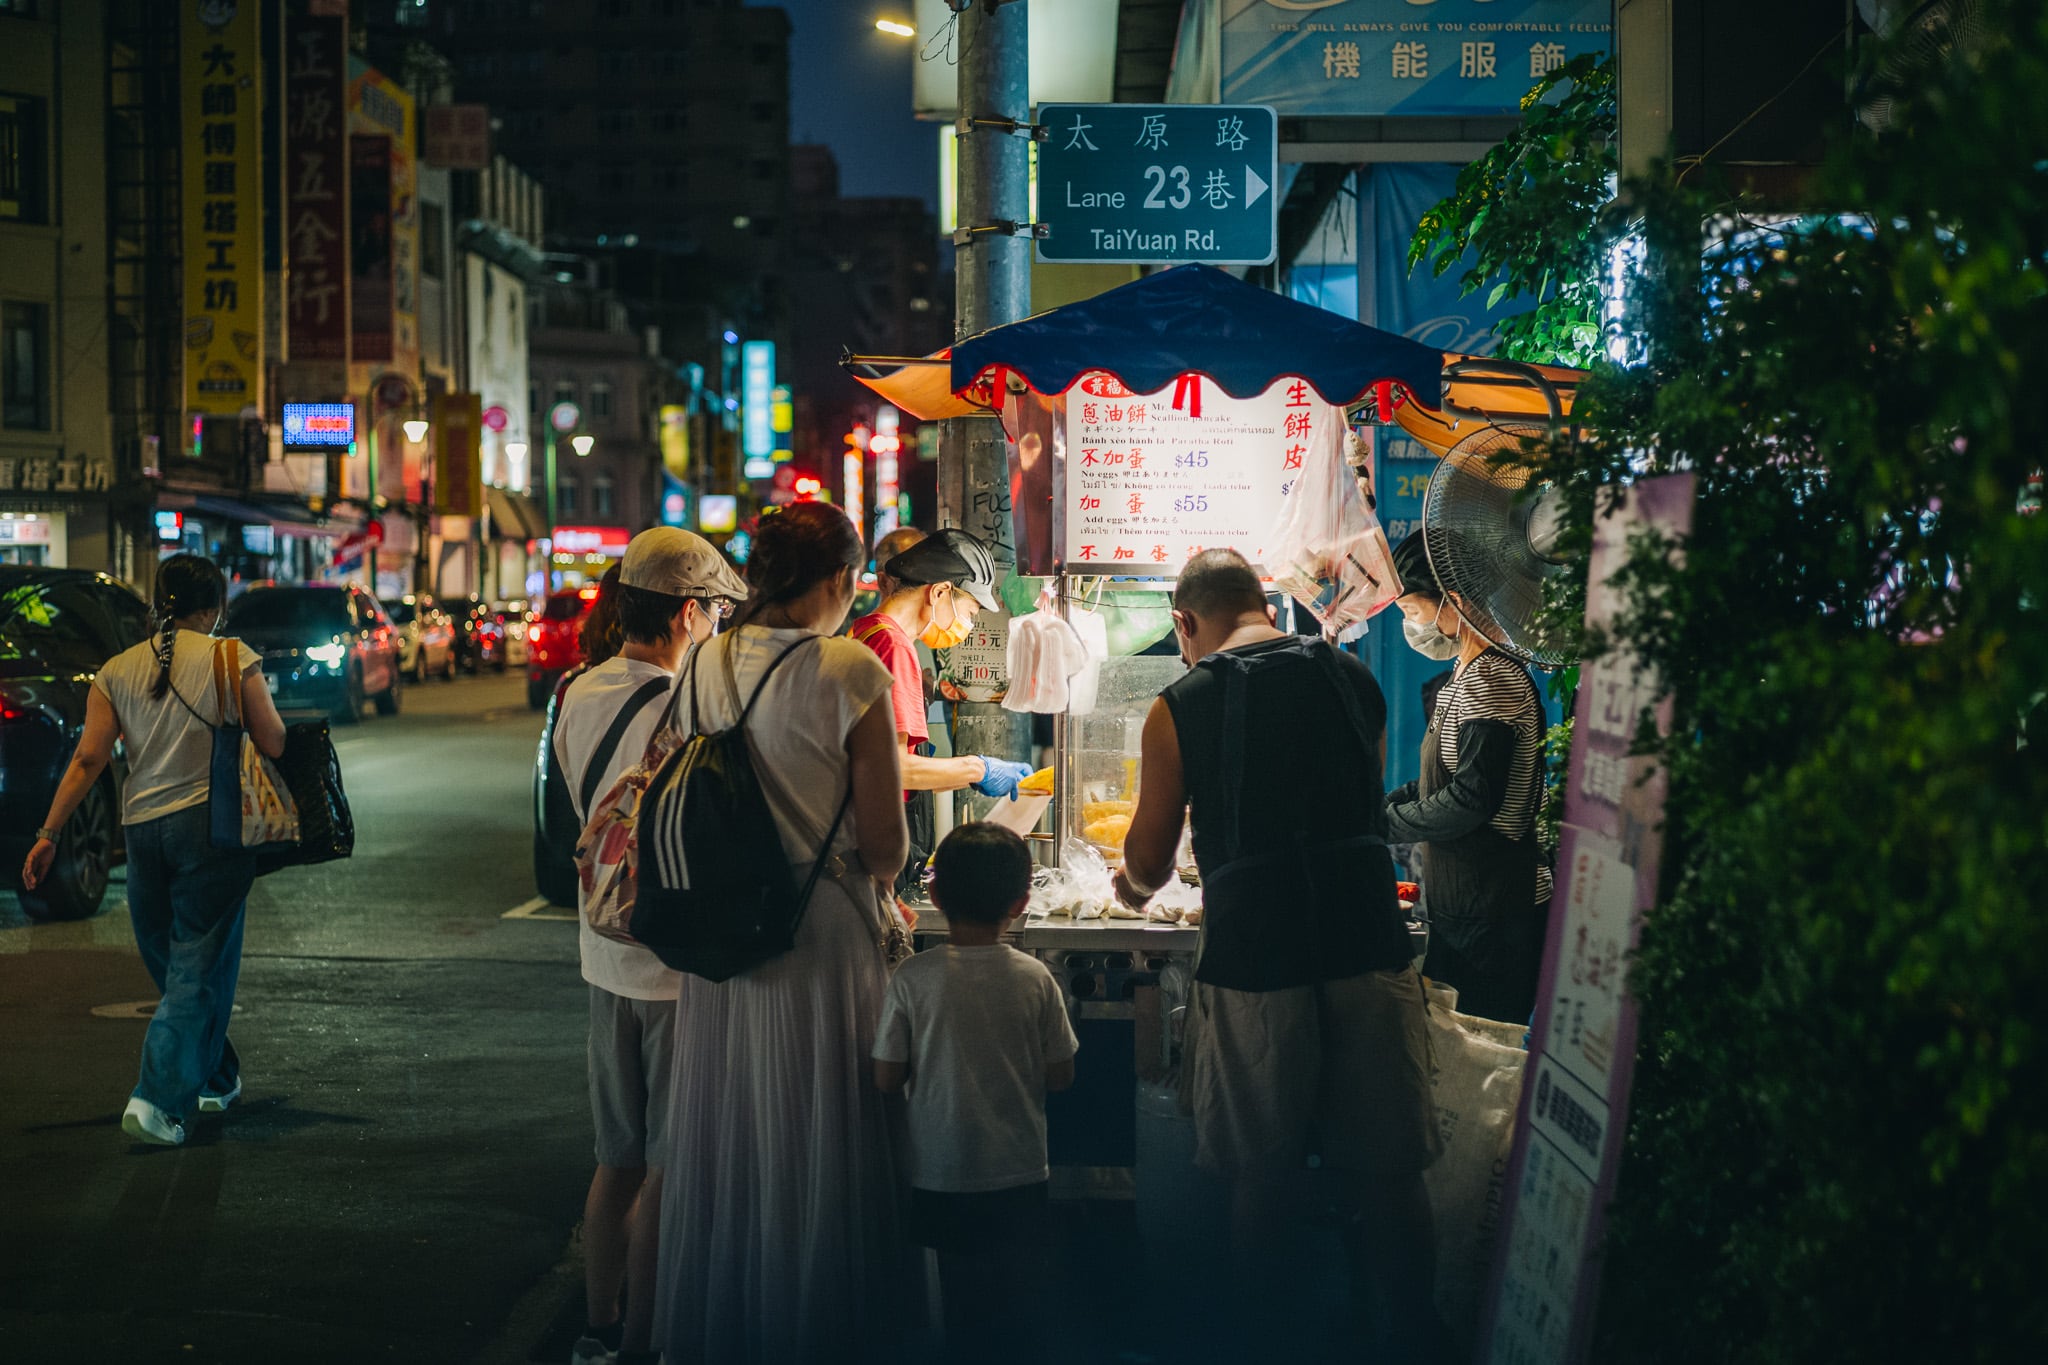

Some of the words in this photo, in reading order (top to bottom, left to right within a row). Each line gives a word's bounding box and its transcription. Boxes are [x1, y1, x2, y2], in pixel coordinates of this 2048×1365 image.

[1270, 23, 1299, 32] THIS
[1306, 23, 1337, 32] WILL
[1344, 23, 1394, 32] ALWAYS
[1400, 23, 1430, 32] GIVE
[1437, 23, 1463, 32] YOU
[1469, 23, 1562, 32] COMFORTABLE
[1323, 41, 1567, 79] 機能服飾
[1064, 114, 1250, 151] 太原路
[201, 43, 238, 312] 大師傅蛋塔工坊
[289, 31, 339, 324] 正源五金行
[1067, 181, 1125, 208] Lane
[1143, 165, 1191, 209] 23
[1200, 168, 1236, 209] 巷
[1091, 229, 1176, 251] TaiYuan
[1185, 229, 1220, 250] Rd.
[1152, 413, 1189, 422] Scallion
[1282, 380, 1312, 471] 生餅皮
[1080, 447, 1147, 470] 不加蛋
[1175, 450, 1209, 468] $45
[1081, 470, 1096, 478] No
[1098, 471, 1119, 480] eggs
[1174, 494, 1208, 512] $55
[1083, 516, 1103, 524] Add
[1106, 517, 1128, 526] eggs
[963, 665, 1000, 681] 折10元
